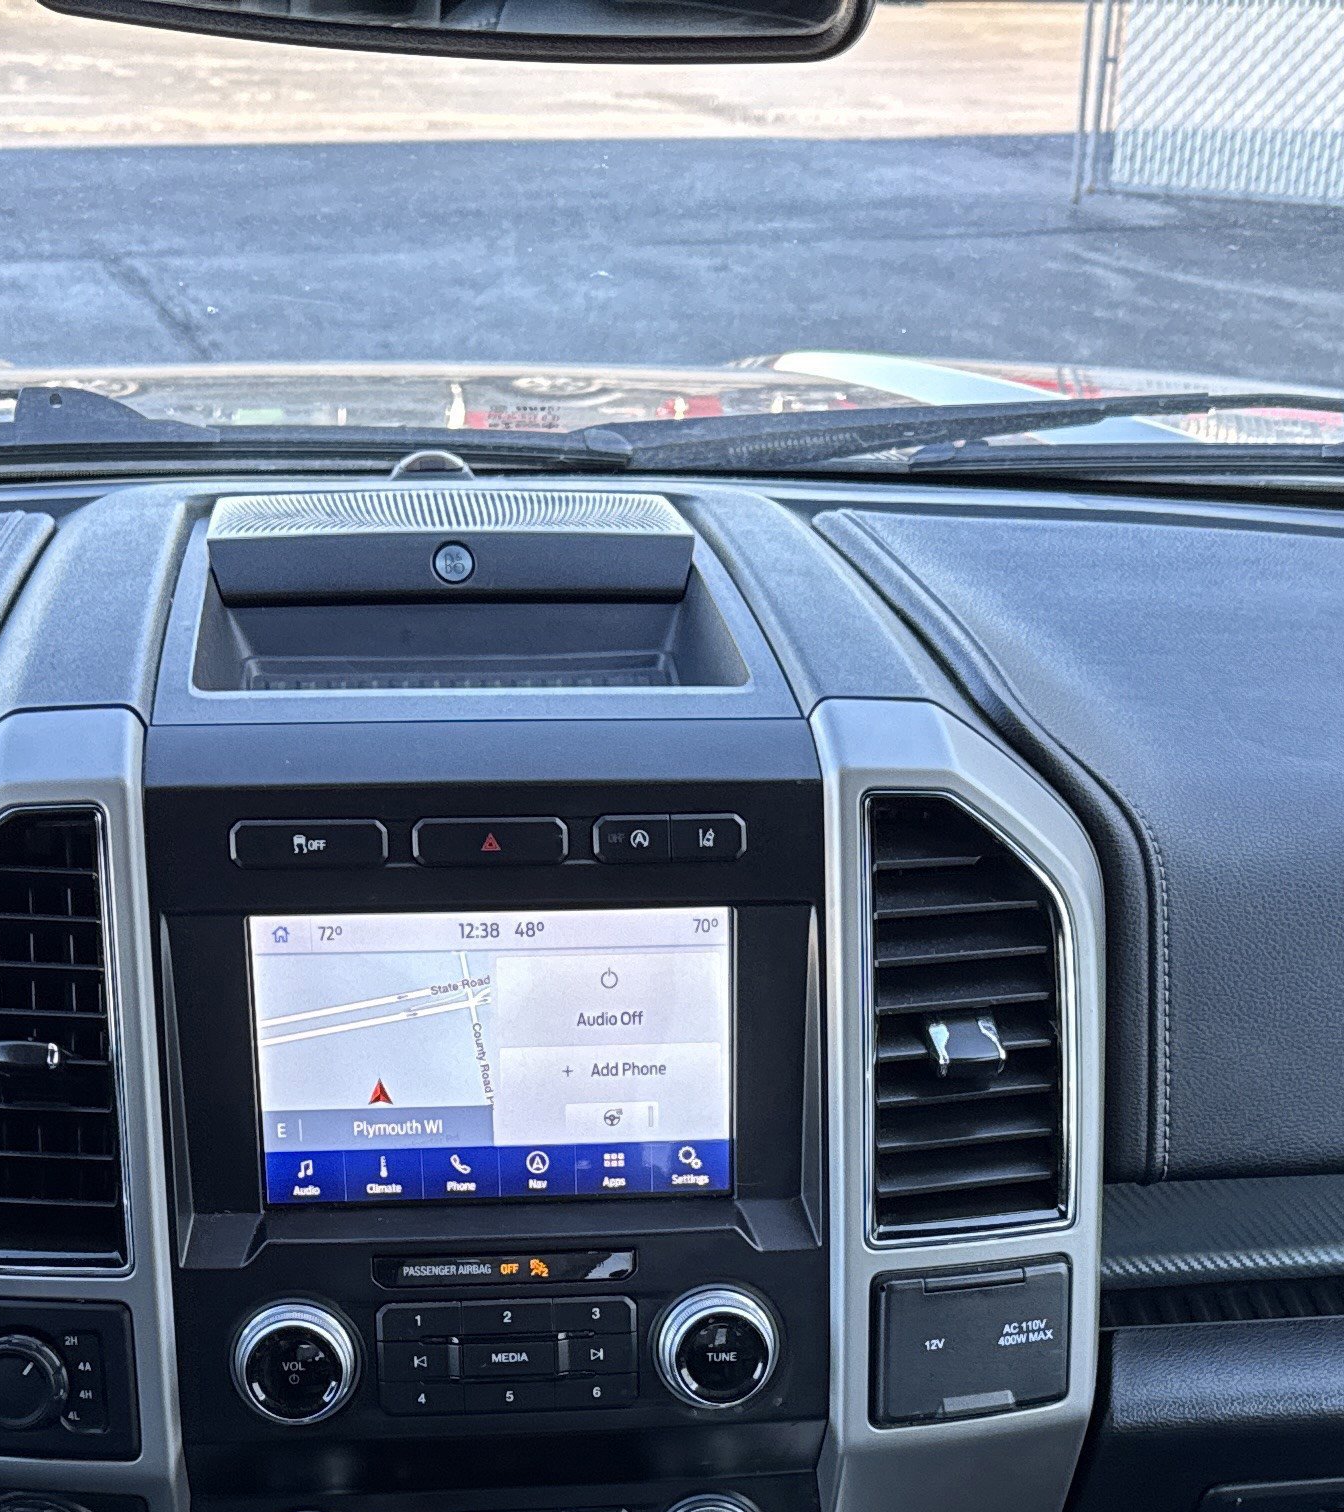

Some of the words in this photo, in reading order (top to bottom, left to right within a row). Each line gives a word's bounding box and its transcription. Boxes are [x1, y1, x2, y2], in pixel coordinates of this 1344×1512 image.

[308, 839, 326, 850] OFF
[458, 922, 500, 939] 12:38
[430, 979, 459, 996] State
[461, 975, 491, 990] Road
[576, 1011, 618, 1028] Audio
[621, 1010, 644, 1026] Off
[472, 1023, 487, 1062] County
[480, 1063, 494, 1094] Road
[591, 1061, 620, 1077] Add
[623, 1060, 667, 1076] Phone
[277, 1123, 286, 1138] E
[353, 1119, 421, 1138] Plymouth
[424, 1119, 443, 1134] WI
[447, 1180, 476, 1192] Phone
[529, 1179, 547, 1189] Nav
[603, 1176, 626, 1188] Apps
[671, 1174, 709, 1187] Settings
[293, 1184, 320, 1196] Audio
[366, 1182, 402, 1194] Climate
[403, 1265, 456, 1277] PASSENGER
[458, 1263, 492, 1276] AIRBAG
[500, 1263, 519, 1275] OFF
[503, 1311, 512, 1323] 2
[591, 1308, 600, 1320] 3
[415, 1315, 421, 1327] 1
[1002, 1323, 1019, 1335] AC
[1021, 1319, 1047, 1331] 110V
[64, 1336, 78, 1346] 2H
[998, 1333, 1027, 1346] 400W
[1029, 1329, 1053, 1342] MAX
[925, 1339, 945, 1350] 12V
[491, 1351, 529, 1364] MEDIA
[706, 1351, 737, 1363] TUNE
[78, 1362, 91, 1371] 4A
[282, 1361, 305, 1373] VOL
[80, 1390, 92, 1399] 4H
[505, 1391, 514, 1402] 5
[593, 1386, 601, 1398] 6
[417, 1393, 426, 1404] 4
[68, 1411, 80, 1421] 4L
